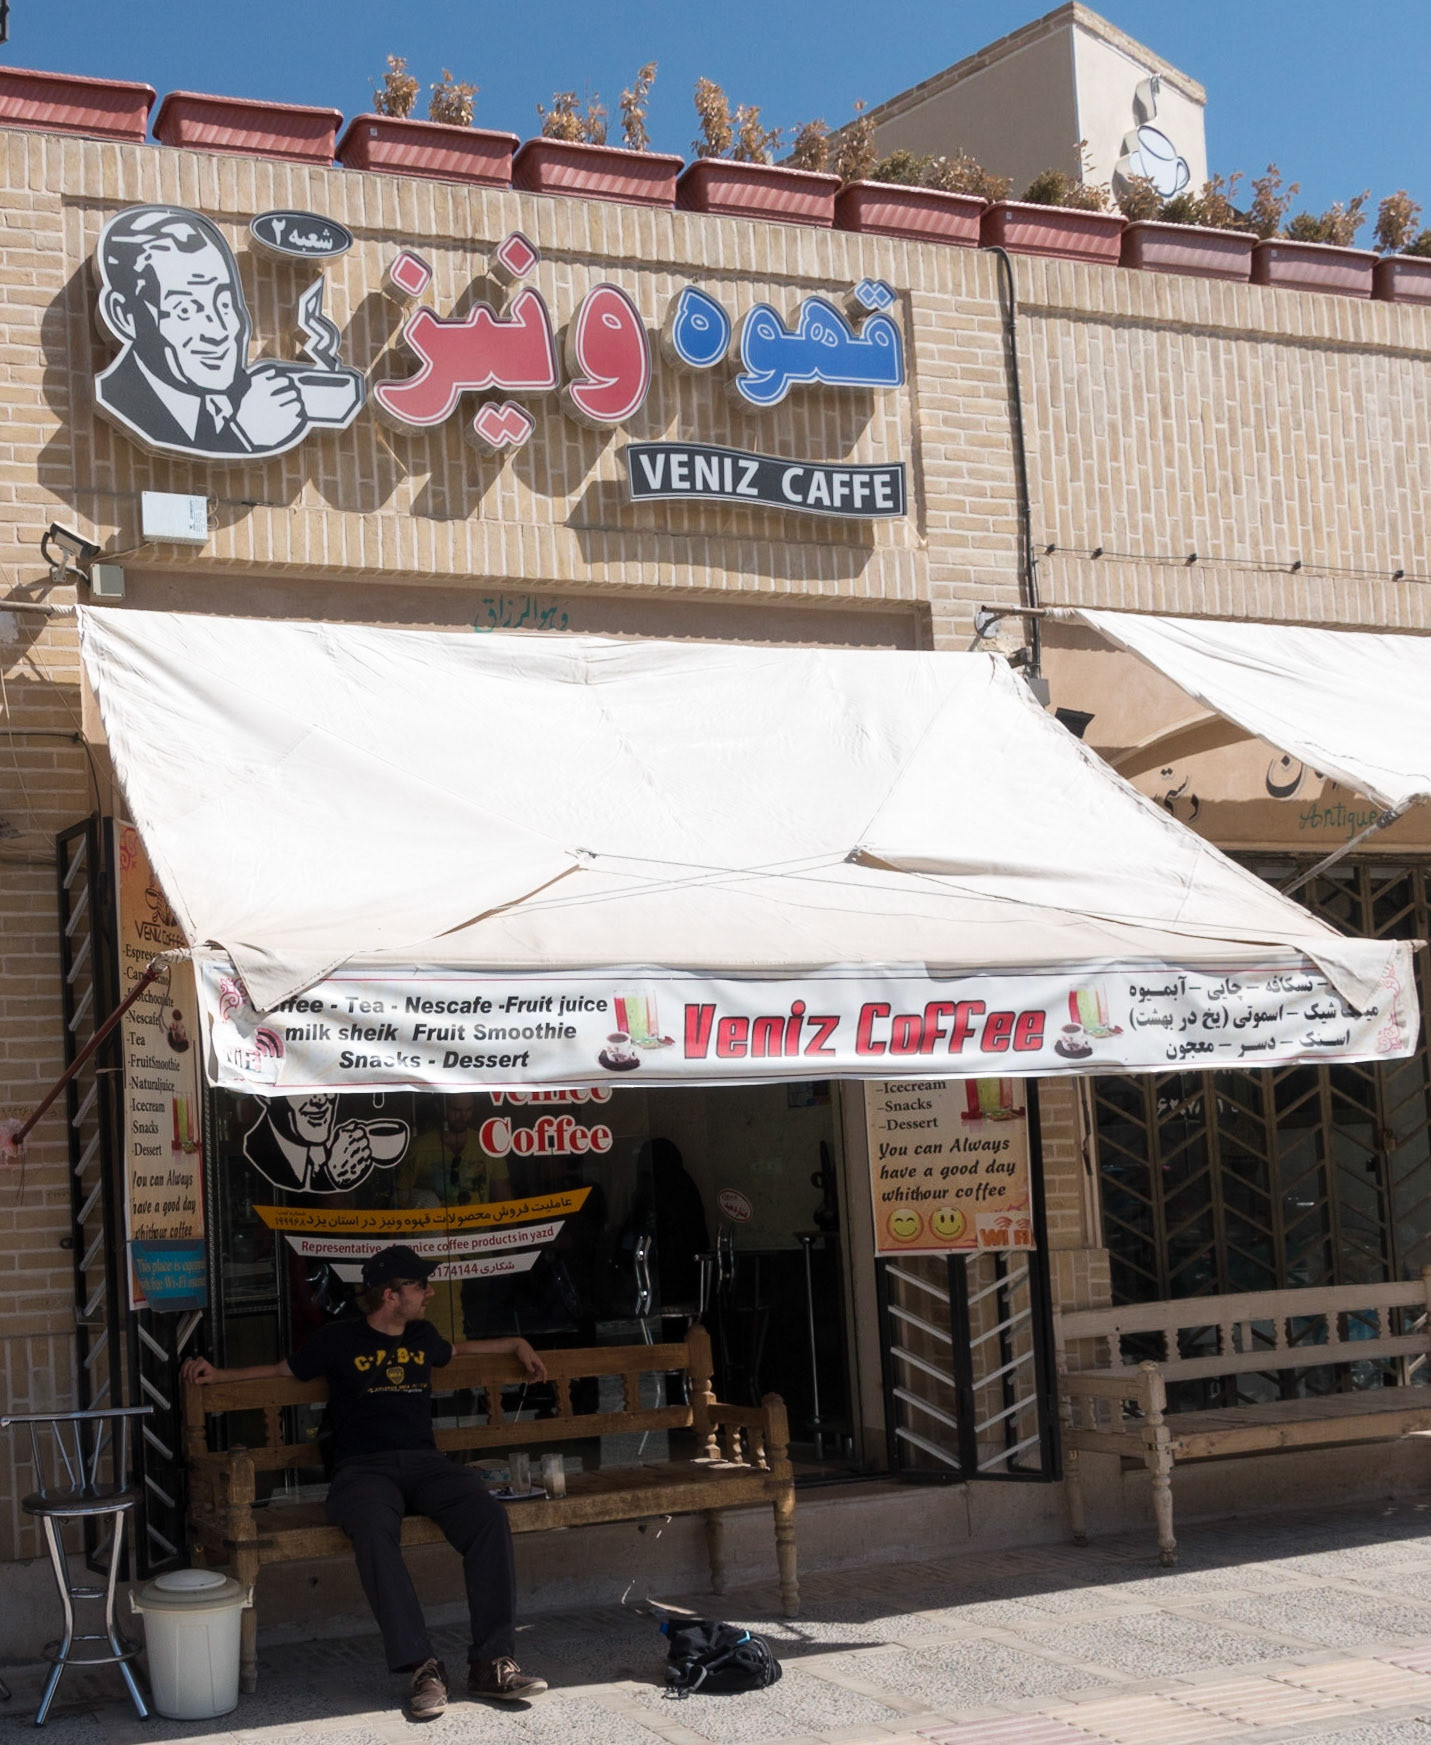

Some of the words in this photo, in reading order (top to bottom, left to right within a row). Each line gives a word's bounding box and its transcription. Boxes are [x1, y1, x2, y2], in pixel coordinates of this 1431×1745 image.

[289, 229, 333, 251] شعبه
[373, 231, 652, 448] ونیز
[673, 279, 903, 406] قهوه
[639, 453, 759, 495] VENIZ
[782, 467, 894, 508] CAFFE
[1300, 802, 1377, 840] Antique
[1129, 976, 1186, 1003] آبمیوه
[1265, 974, 1312, 993] نسکافه
[347, 997, 384, 1013] Tea
[405, 996, 492, 1014] Nescafe
[557, 996, 608, 1014] juice
[1303, 1003, 1336, 1024] شیک
[1129, 1006, 1173, 1029] بهشت)
[1179, 1010, 1197, 1032] در
[1202, 1005, 1228, 1029] (یخ
[1233, 1005, 1283, 1028] اسموتی
[285, 1023, 330, 1042] milk
[338, 1023, 398, 1042] sheik
[412, 1024, 465, 1042] Fruit
[474, 1023, 577, 1042] Smoothie
[684, 999, 839, 1060] Veniz
[1299, 1030, 1350, 1048] اسنک
[1166, 1041, 1214, 1061] معجون
[1238, 1036, 1276, 1057] دسر
[339, 1050, 421, 1069] Snacks
[442, 1050, 529, 1069] Dessert
[481, 1115, 613, 1157] Coffee
[879, 1142, 908, 1160] You
[914, 1143, 943, 1156] can
[950, 1137, 1011, 1156] Always
[880, 1164, 917, 1180] have
[923, 1167, 933, 1178] a
[940, 1160, 980, 1180] good
[985, 1159, 1017, 1177] day
[150, 1175, 164, 1187] can
[881, 1185, 950, 1203] whithour
[955, 1182, 1007, 1202] coffee
[154, 1202, 160, 1213] a
[163, 1195, 180, 1216] good
[183, 1195, 196, 1214] day
[493, 1203, 529, 1221] فروش
[532, 1197, 572, 1213] عاملیت
[306, 1216, 327, 1228] یزد
[328, 1215, 359, 1227] استان
[362, 1217, 377, 1229] در
[379, 1218, 402, 1230] ونیز
[405, 1214, 430, 1229] قهوه
[432, 1212, 491, 1227] محصولات
[302, 1241, 382, 1254] Representative
[437, 1239, 469, 1252] coffee
[471, 1232, 517, 1250] products
[518, 1232, 529, 1242] in
[530, 1226, 554, 1243] yazd
[480, 1262, 515, 1274] شکاری
